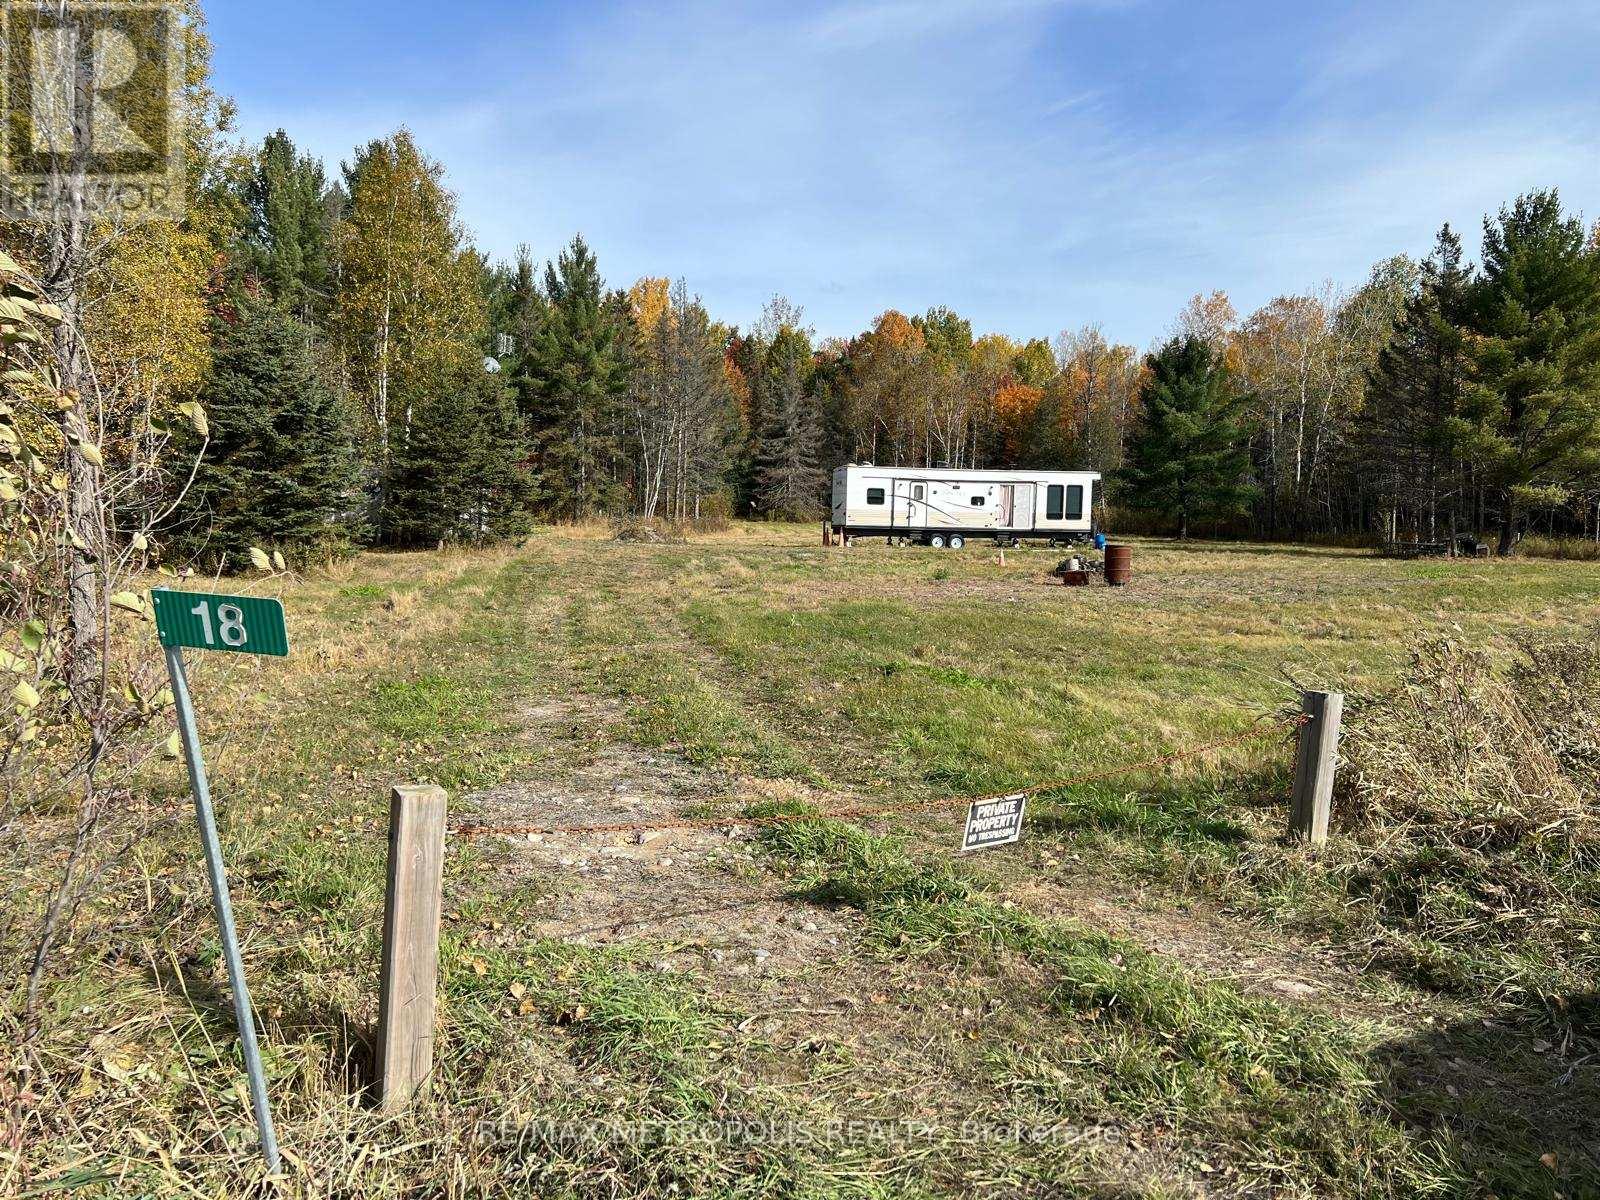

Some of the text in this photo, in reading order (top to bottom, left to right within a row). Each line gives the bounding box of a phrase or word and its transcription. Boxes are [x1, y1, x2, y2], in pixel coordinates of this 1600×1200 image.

[191, 600, 247, 647] 18
[977, 801, 1017, 818] PRIVATE
[969, 813, 1019, 832] PROPERTY
[967, 834, 977, 843] NO
